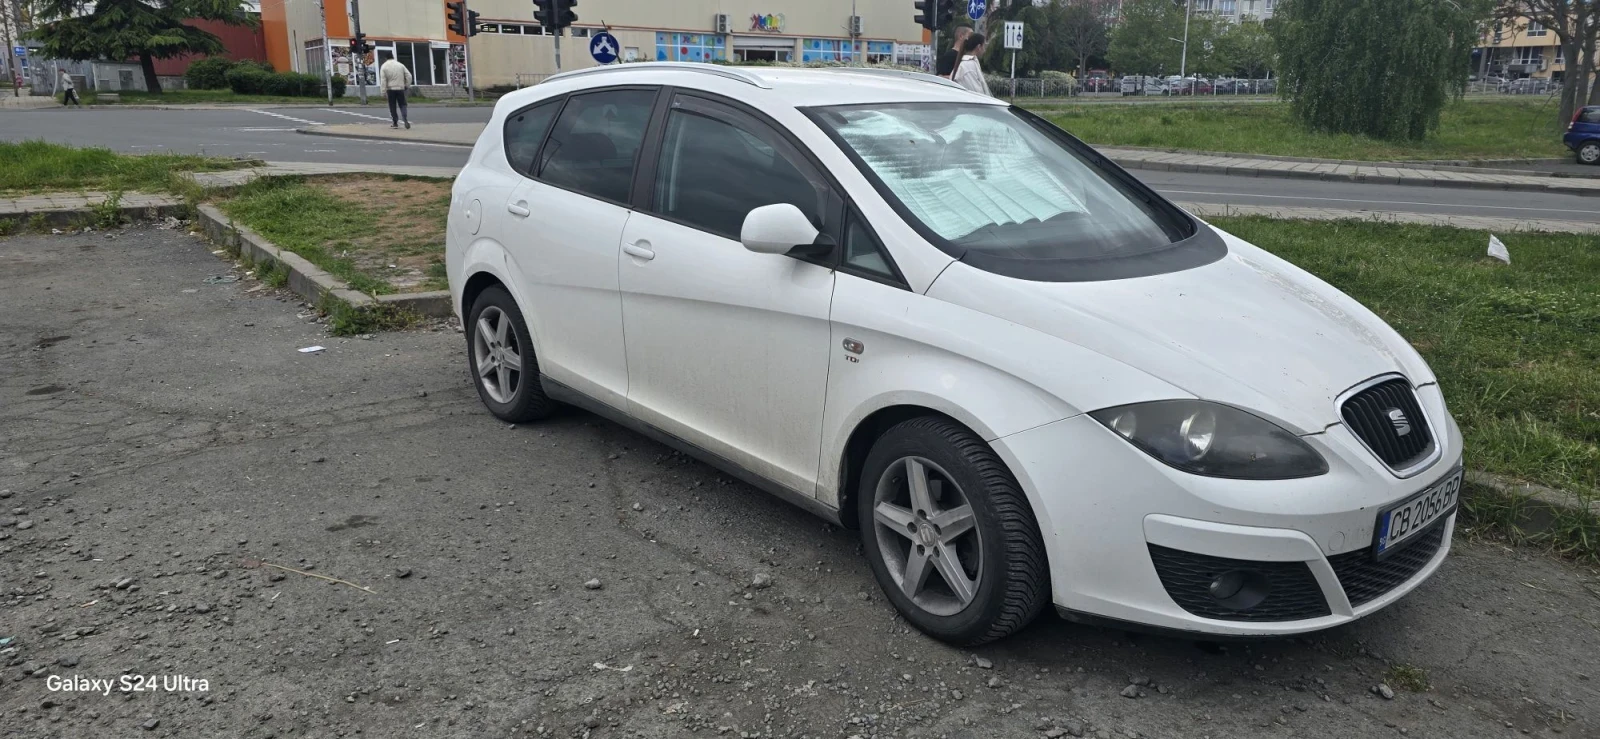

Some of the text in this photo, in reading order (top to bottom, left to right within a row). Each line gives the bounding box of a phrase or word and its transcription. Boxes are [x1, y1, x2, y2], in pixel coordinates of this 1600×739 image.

[1390, 476, 1460, 541] CB 2056 BP
